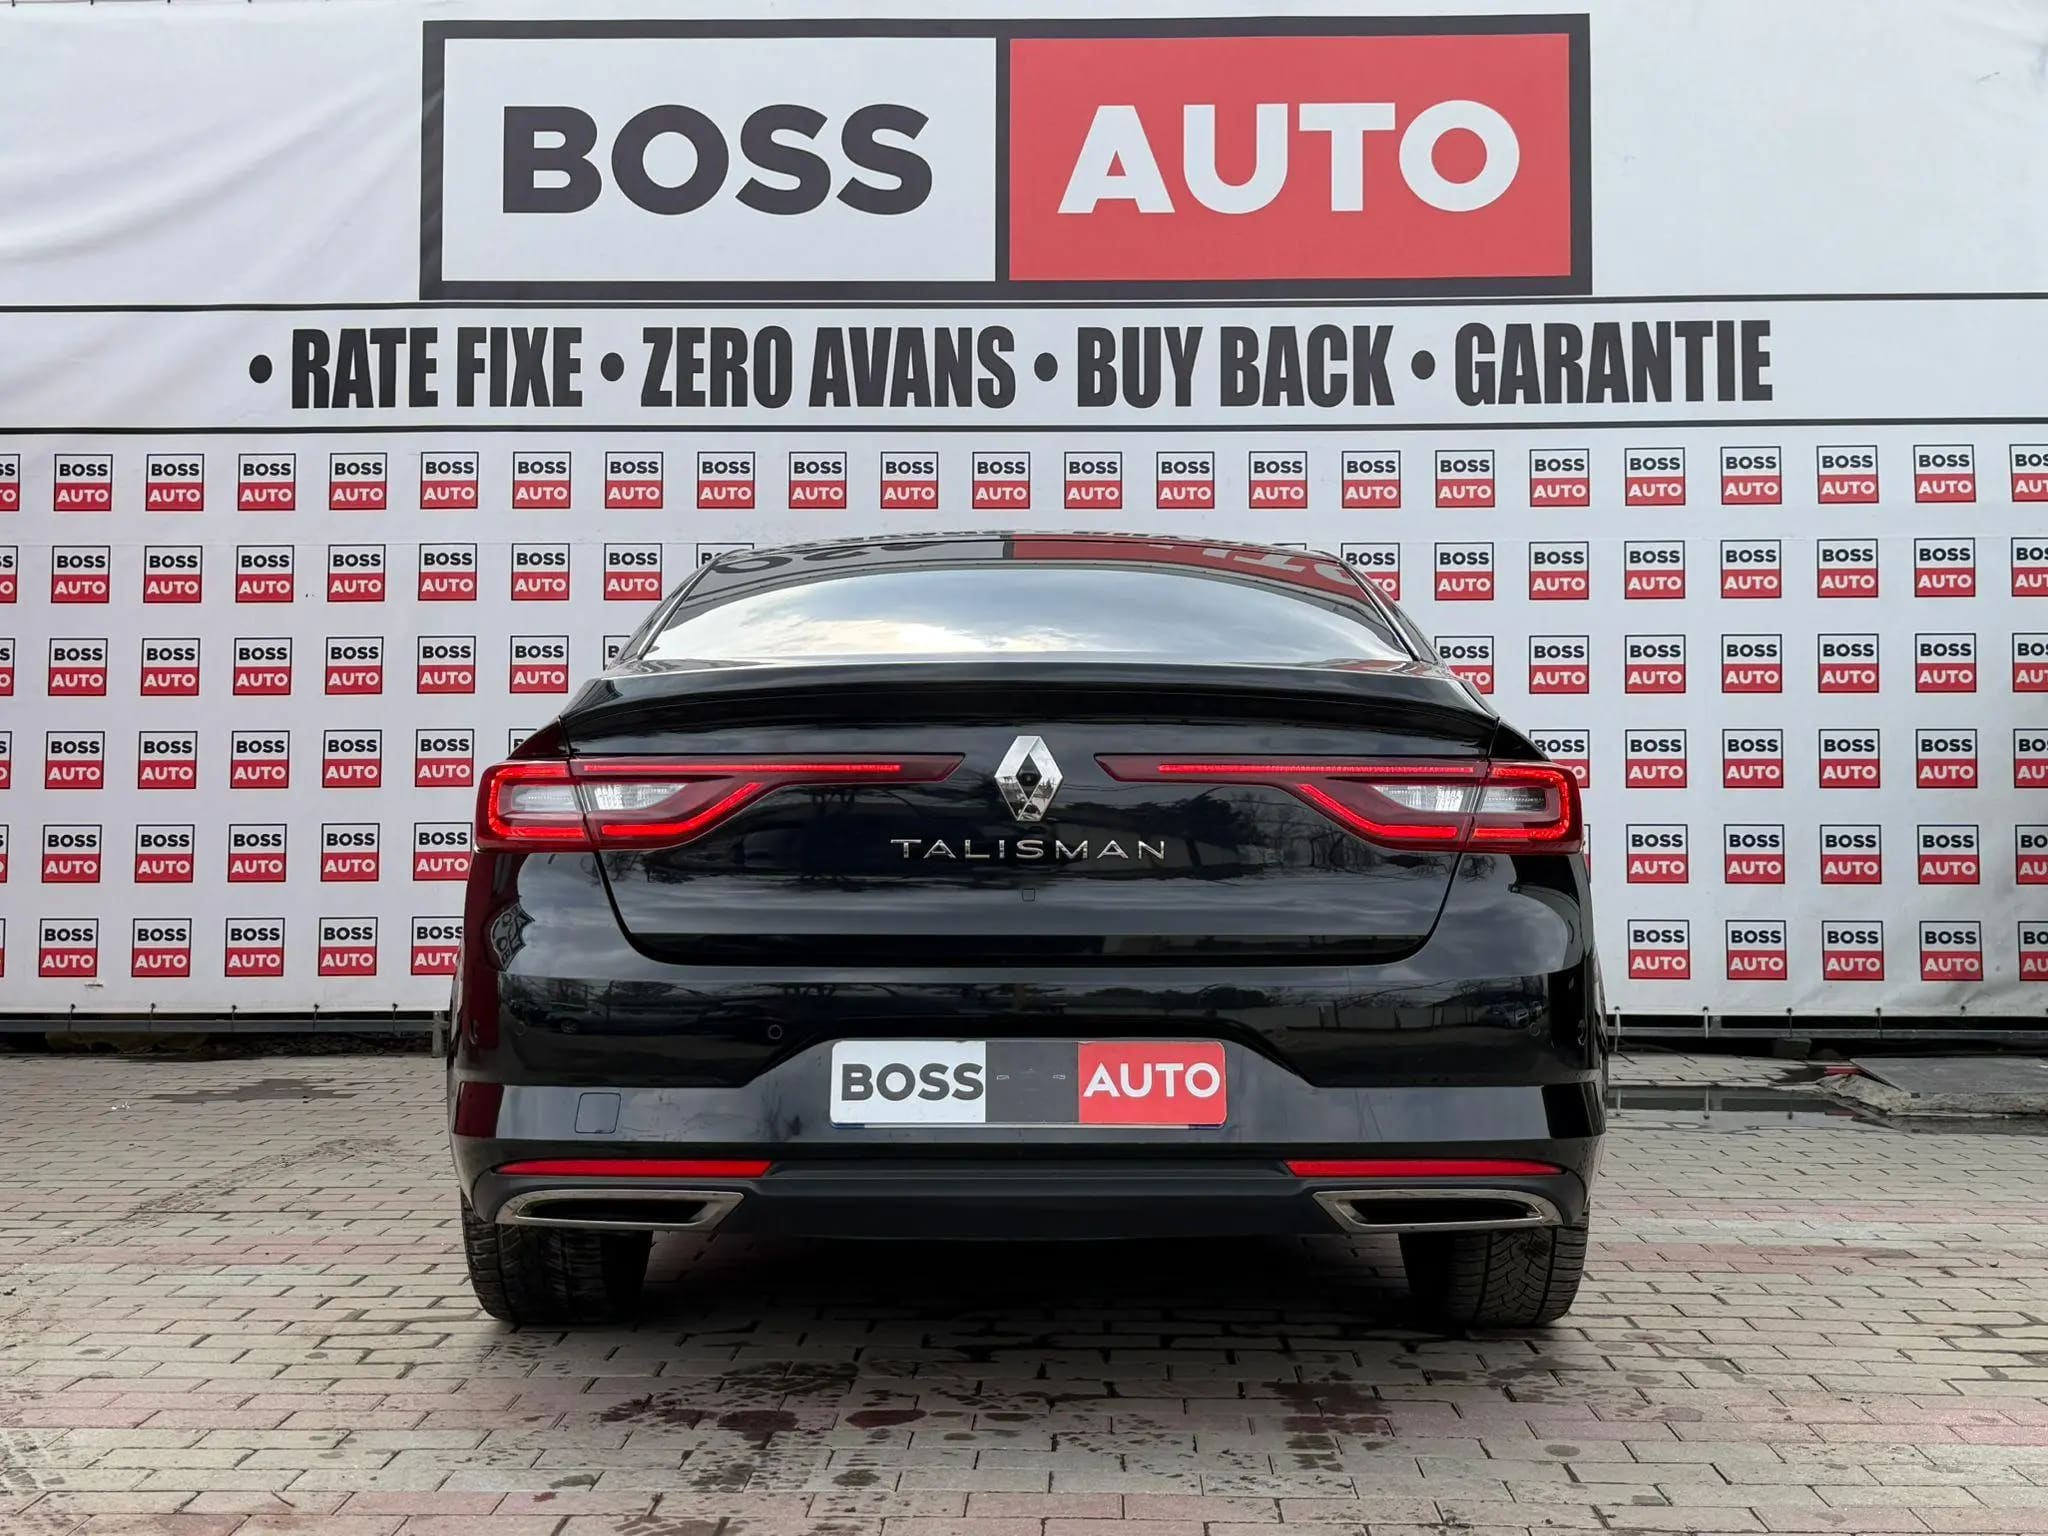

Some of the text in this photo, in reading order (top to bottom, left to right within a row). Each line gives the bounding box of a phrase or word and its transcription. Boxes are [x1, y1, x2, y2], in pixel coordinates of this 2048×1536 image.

[502, 99, 1520, 216] BOSS AUTO
[291, 319, 1773, 410] RATE FIXE ZERO AVANS BUY BACK GARANTIE
[425, 461, 474, 475] BOSS
[517, 461, 567, 475] BOSS
[610, 460, 659, 475] BOSS
[702, 461, 751, 475] BOSS
[793, 461, 843, 475] BOSS
[885, 461, 934, 475] BOSS
[977, 461, 1026, 475] BOSS
[1069, 461, 1118, 475] BOSS
[1161, 460, 1210, 475] BOSS
[1253, 460, 1303, 474] BOSS
[1346, 460, 1396, 474] BOSS
[1440, 459, 1490, 473] BOSS
[1534, 458, 1585, 472] BOSS
[1629, 457, 1681, 471] BOSS
[1725, 455, 1777, 470] BOSS
[1822, 454, 1874, 469] BOSS
[1918, 454, 1970, 468] BOSS
[59, 463, 108, 477] BOSS
[151, 463, 200, 477] BOSS
[243, 462, 292, 477] BOSS
[334, 462, 383, 476] BOSS
[331, 487, 384, 502] AUTO
[423, 486, 475, 501] AUTO
[515, 486, 568, 500] AUTO
[607, 486, 660, 500] AUTO
[699, 486, 752, 500] AUTO
[791, 486, 844, 501] AUTO
[883, 486, 936, 501] AUTO
[975, 486, 1028, 501] AUTO
[1066, 486, 1120, 501] AUTO
[1159, 486, 1212, 501] AUTO
[1251, 486, 1305, 500] AUTO
[1344, 485, 1398, 500] AUTO
[1438, 485, 1492, 499] AUTO
[1532, 484, 1587, 498] AUTO
[1628, 483, 1683, 497] AUTO
[1724, 481, 1779, 496] AUTO
[1821, 480, 1876, 495] AUTO
[1918, 480, 1973, 494] AUTO
[56, 489, 109, 503] AUTO
[148, 488, 201, 503] AUTO
[240, 488, 293, 502] AUTO
[56, 555, 106, 569] BOSS
[149, 554, 198, 569] BOSS
[241, 554, 290, 568] BOSS
[332, 553, 381, 568] BOSS
[423, 552, 473, 566] BOSS
[516, 552, 566, 566] BOSS
[608, 552, 658, 566] BOSS
[1439, 551, 1490, 566] BOSS
[1534, 551, 1585, 565] BOSS
[1629, 550, 1681, 564] BOSS
[1725, 549, 1777, 563] BOSS
[1822, 548, 1874, 563] BOSS
[1919, 547, 1971, 562] BOSS
[54, 580, 107, 595] AUTO
[146, 580, 199, 595] AUTO
[238, 580, 291, 594] AUTO
[330, 579, 382, 594] AUTO
[421, 578, 474, 593] AUTO
[514, 578, 567, 592] AUTO
[606, 578, 659, 592] AUTO
[1437, 577, 1491, 592] AUTO
[1532, 577, 1586, 592] AUTO
[1627, 576, 1682, 591] AUTO
[1723, 575, 1779, 590] AUTO
[1820, 575, 1876, 589] AUTO
[1917, 574, 1972, 589] AUTO
[53, 647, 103, 661] BOSS
[146, 647, 196, 661] BOSS
[238, 647, 288, 661] BOSS
[330, 646, 379, 660] BOSS
[422, 645, 472, 659] BOSS
[515, 644, 564, 659] BOSS
[1534, 645, 1585, 659] BOSS
[1629, 644, 1682, 658] BOSS
[1726, 643, 1778, 658] BOSS
[1823, 643, 1875, 657] BOSS
[1920, 643, 1972, 657] BOSS
[51, 673, 104, 688] AUTO
[143, 673, 196, 687] AUTO
[235, 672, 289, 687] AUTO
[327, 671, 380, 686] AUTO
[420, 671, 473, 685] AUTO
[512, 670, 565, 685] AUTO
[1531, 671, 1586, 686] AUTO
[1627, 670, 1683, 685] AUTO
[1724, 670, 1780, 684] AUTO
[1821, 670, 1876, 684] AUTO
[1918, 669, 1974, 684] AUTO
[50, 740, 100, 755] BOSS
[143, 740, 193, 754] BOSS
[236, 739, 285, 754] BOSS
[327, 739, 378, 753] BOSS
[420, 738, 470, 752] BOSS
[1630, 738, 1682, 753] BOSS
[1727, 738, 1779, 753] BOSS
[1823, 738, 1876, 753] BOSS
[1921, 738, 1973, 753] BOSS
[47, 766, 101, 781] AUTO
[141, 766, 194, 781] AUTO
[233, 765, 286, 780] AUTO
[325, 765, 378, 779] AUTO
[417, 764, 471, 779] AUTO
[1628, 765, 1684, 780] AUTO
[1726, 765, 1781, 780] AUTO
[1822, 765, 1877, 780] AUTO
[1919, 765, 1975, 780] AUTO
[47, 834, 97, 848] BOSS
[140, 834, 190, 848] BOSS
[233, 833, 282, 847] BOSS
[326, 832, 376, 847] BOSS
[1631, 833, 1684, 848] BOSS
[1729, 834, 1780, 848] BOSS
[1825, 834, 1877, 849] BOSS
[1922, 834, 1975, 849] BOSS
[890, 839, 1165, 860] TALISMAN
[44, 860, 98, 874] AUTO
[137, 860, 191, 874] AUTO
[231, 859, 283, 874] AUTO
[323, 858, 376, 873] AUTO
[1629, 860, 1686, 875] AUTO
[1727, 860, 1782, 875] AUTO
[1823, 861, 1879, 875] AUTO
[1921, 861, 1977, 876] AUTO
[44, 928, 94, 942] BOSS
[137, 928, 187, 942] BOSS
[230, 927, 281, 942] BOSS
[323, 926, 373, 941] BOSS
[1633, 929, 1685, 944] BOSS
[1731, 930, 1782, 944] BOSS
[1827, 930, 1879, 945] BOSS
[41, 954, 95, 969] AUTO
[134, 954, 188, 969] AUTO
[228, 953, 281, 968] AUTO
[321, 953, 374, 967] AUTO
[1631, 956, 1687, 971] AUTO
[1729, 956, 1784, 971] AUTO
[1826, 957, 1881, 972] AUTO
[841, 1062, 1221, 1102] BOSS AUTO
